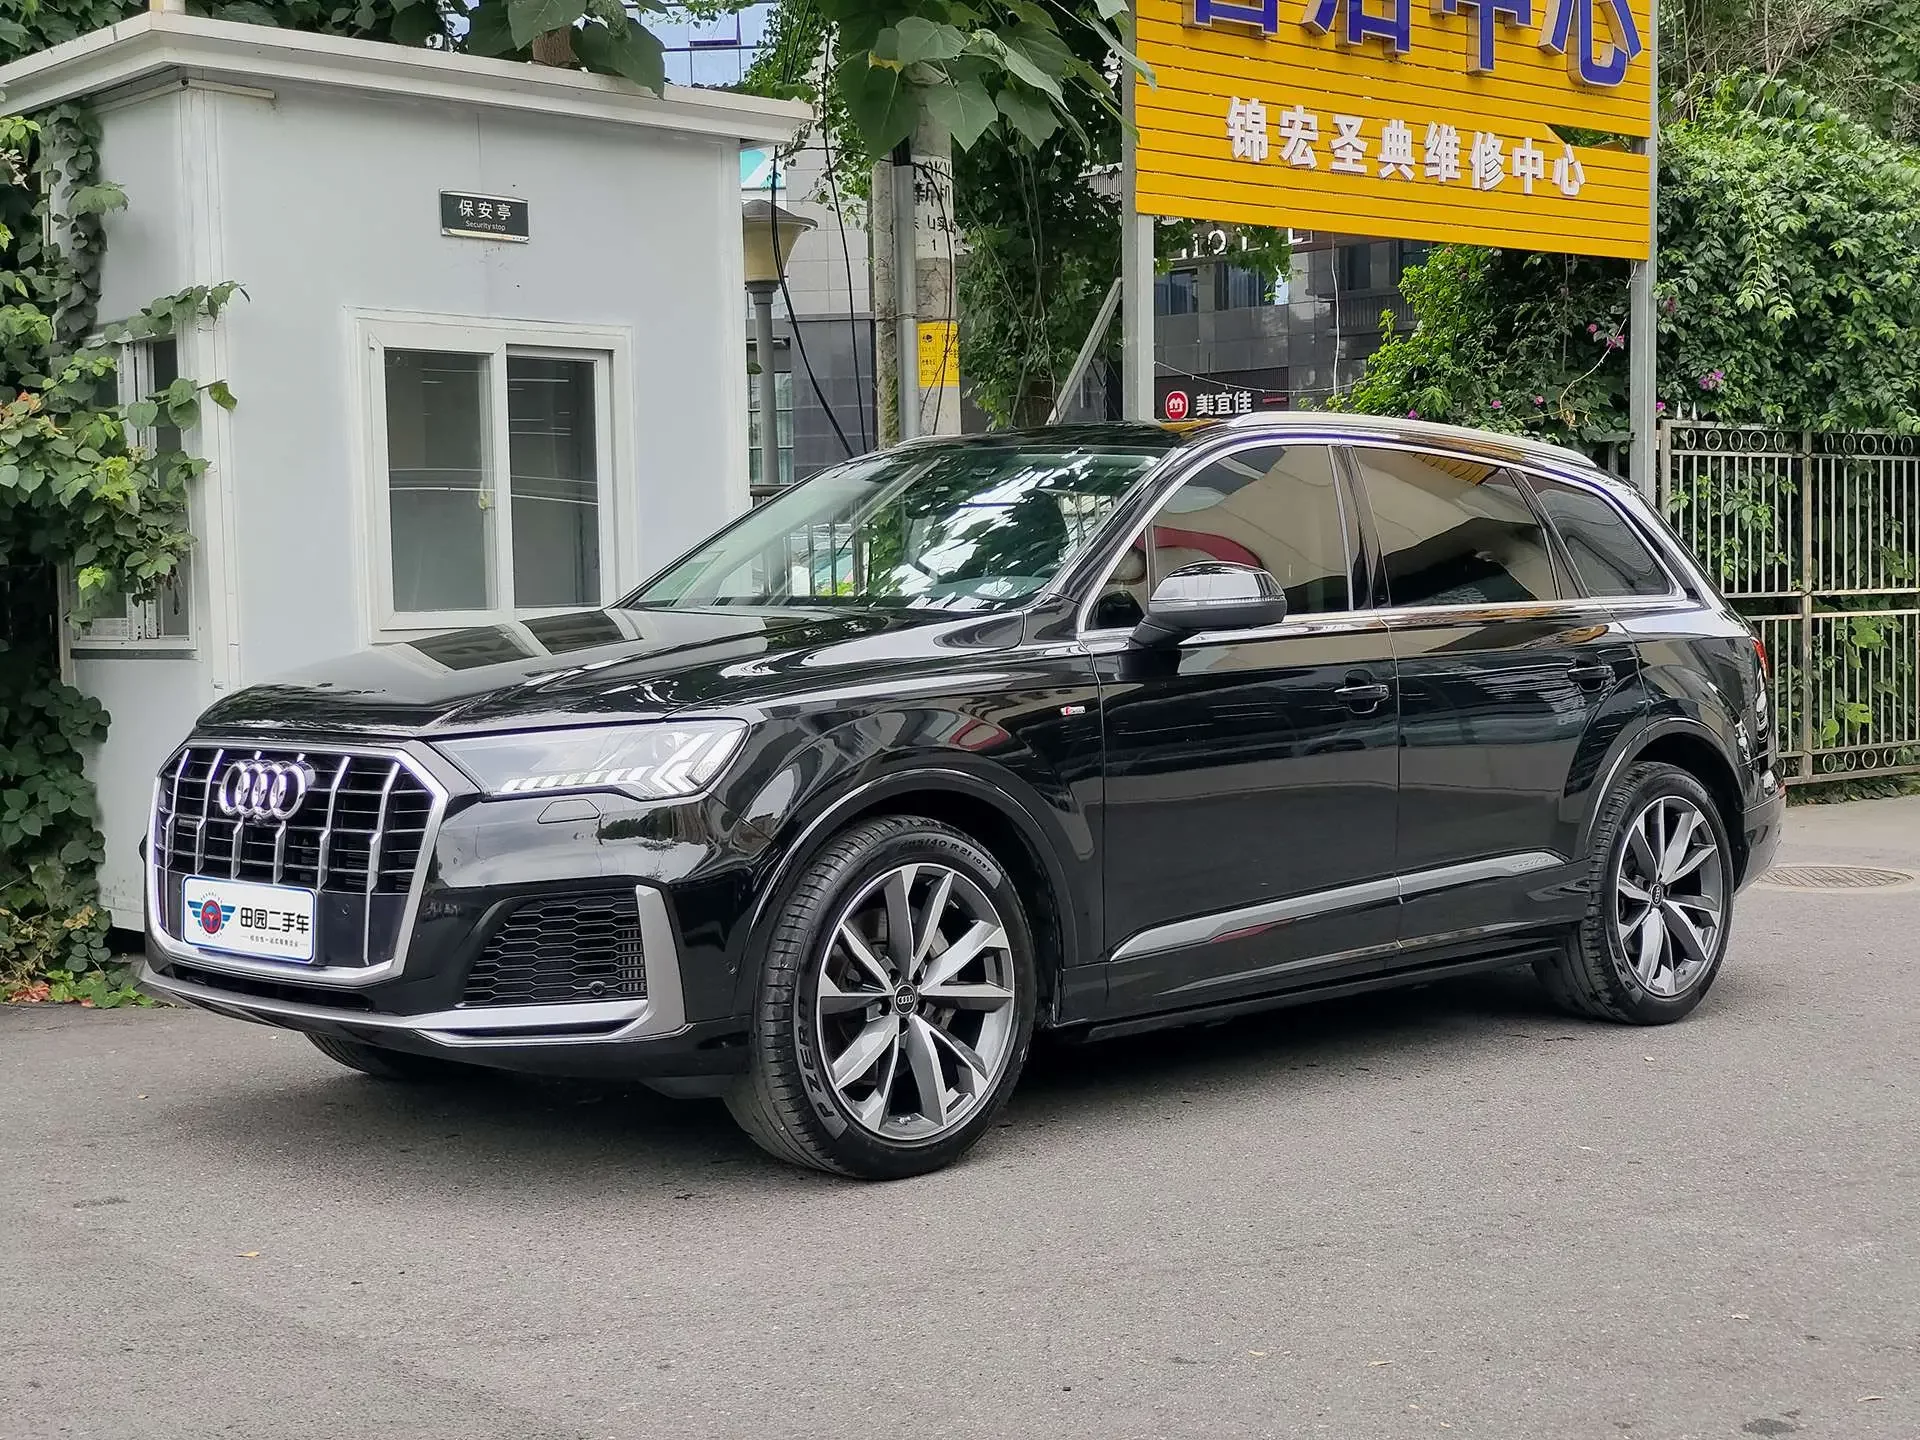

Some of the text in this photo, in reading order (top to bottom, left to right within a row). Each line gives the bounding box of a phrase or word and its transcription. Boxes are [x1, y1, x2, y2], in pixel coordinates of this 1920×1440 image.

[1226, 96, 1586, 197] 锦宏圣典维修中心
[458, 198, 512, 221] 保安亭
[465, 220, 506, 232] Security stop
[1195, 391, 1253, 416] 美宜佳
[240, 907, 309, 934] 田园二手车
[817, 1102, 835, 1118] P
